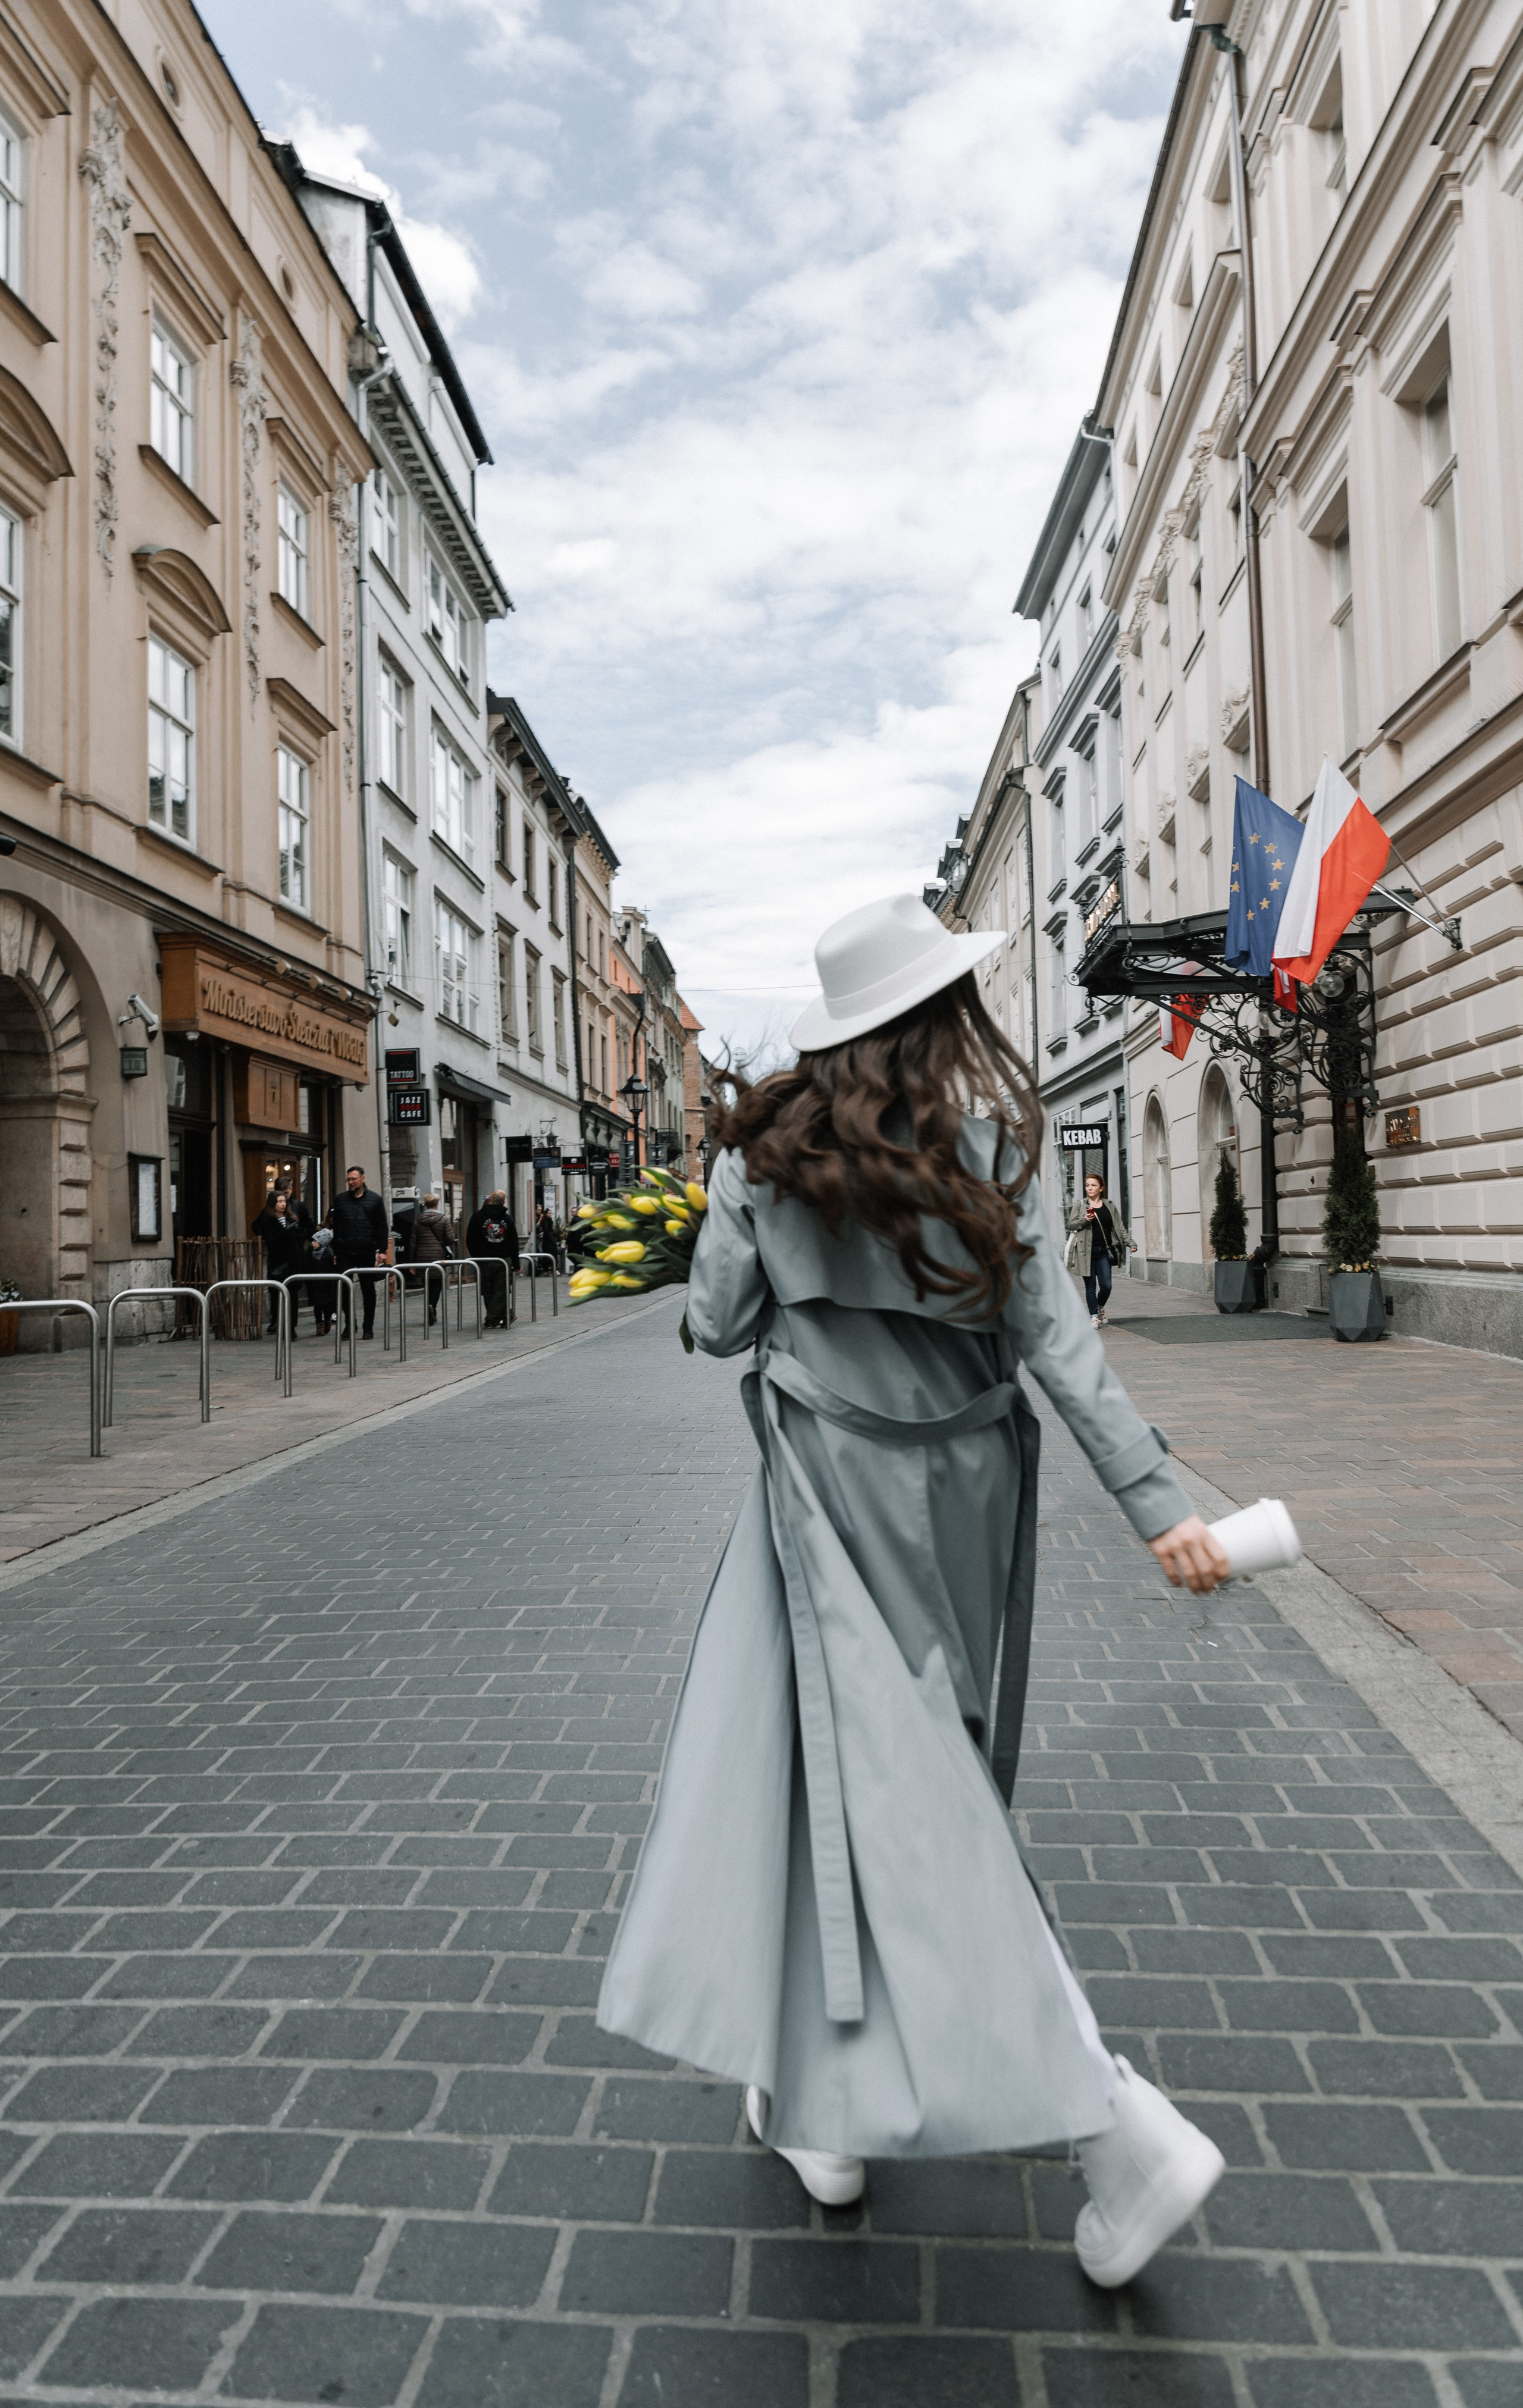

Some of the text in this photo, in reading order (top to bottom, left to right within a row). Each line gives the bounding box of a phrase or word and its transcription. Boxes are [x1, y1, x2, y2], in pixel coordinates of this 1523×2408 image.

[203, 978, 288, 1036] Ministerstwo
[390, 1070, 415, 1079] TATTOO
[1063, 1129, 1102, 1145] KEBAB
